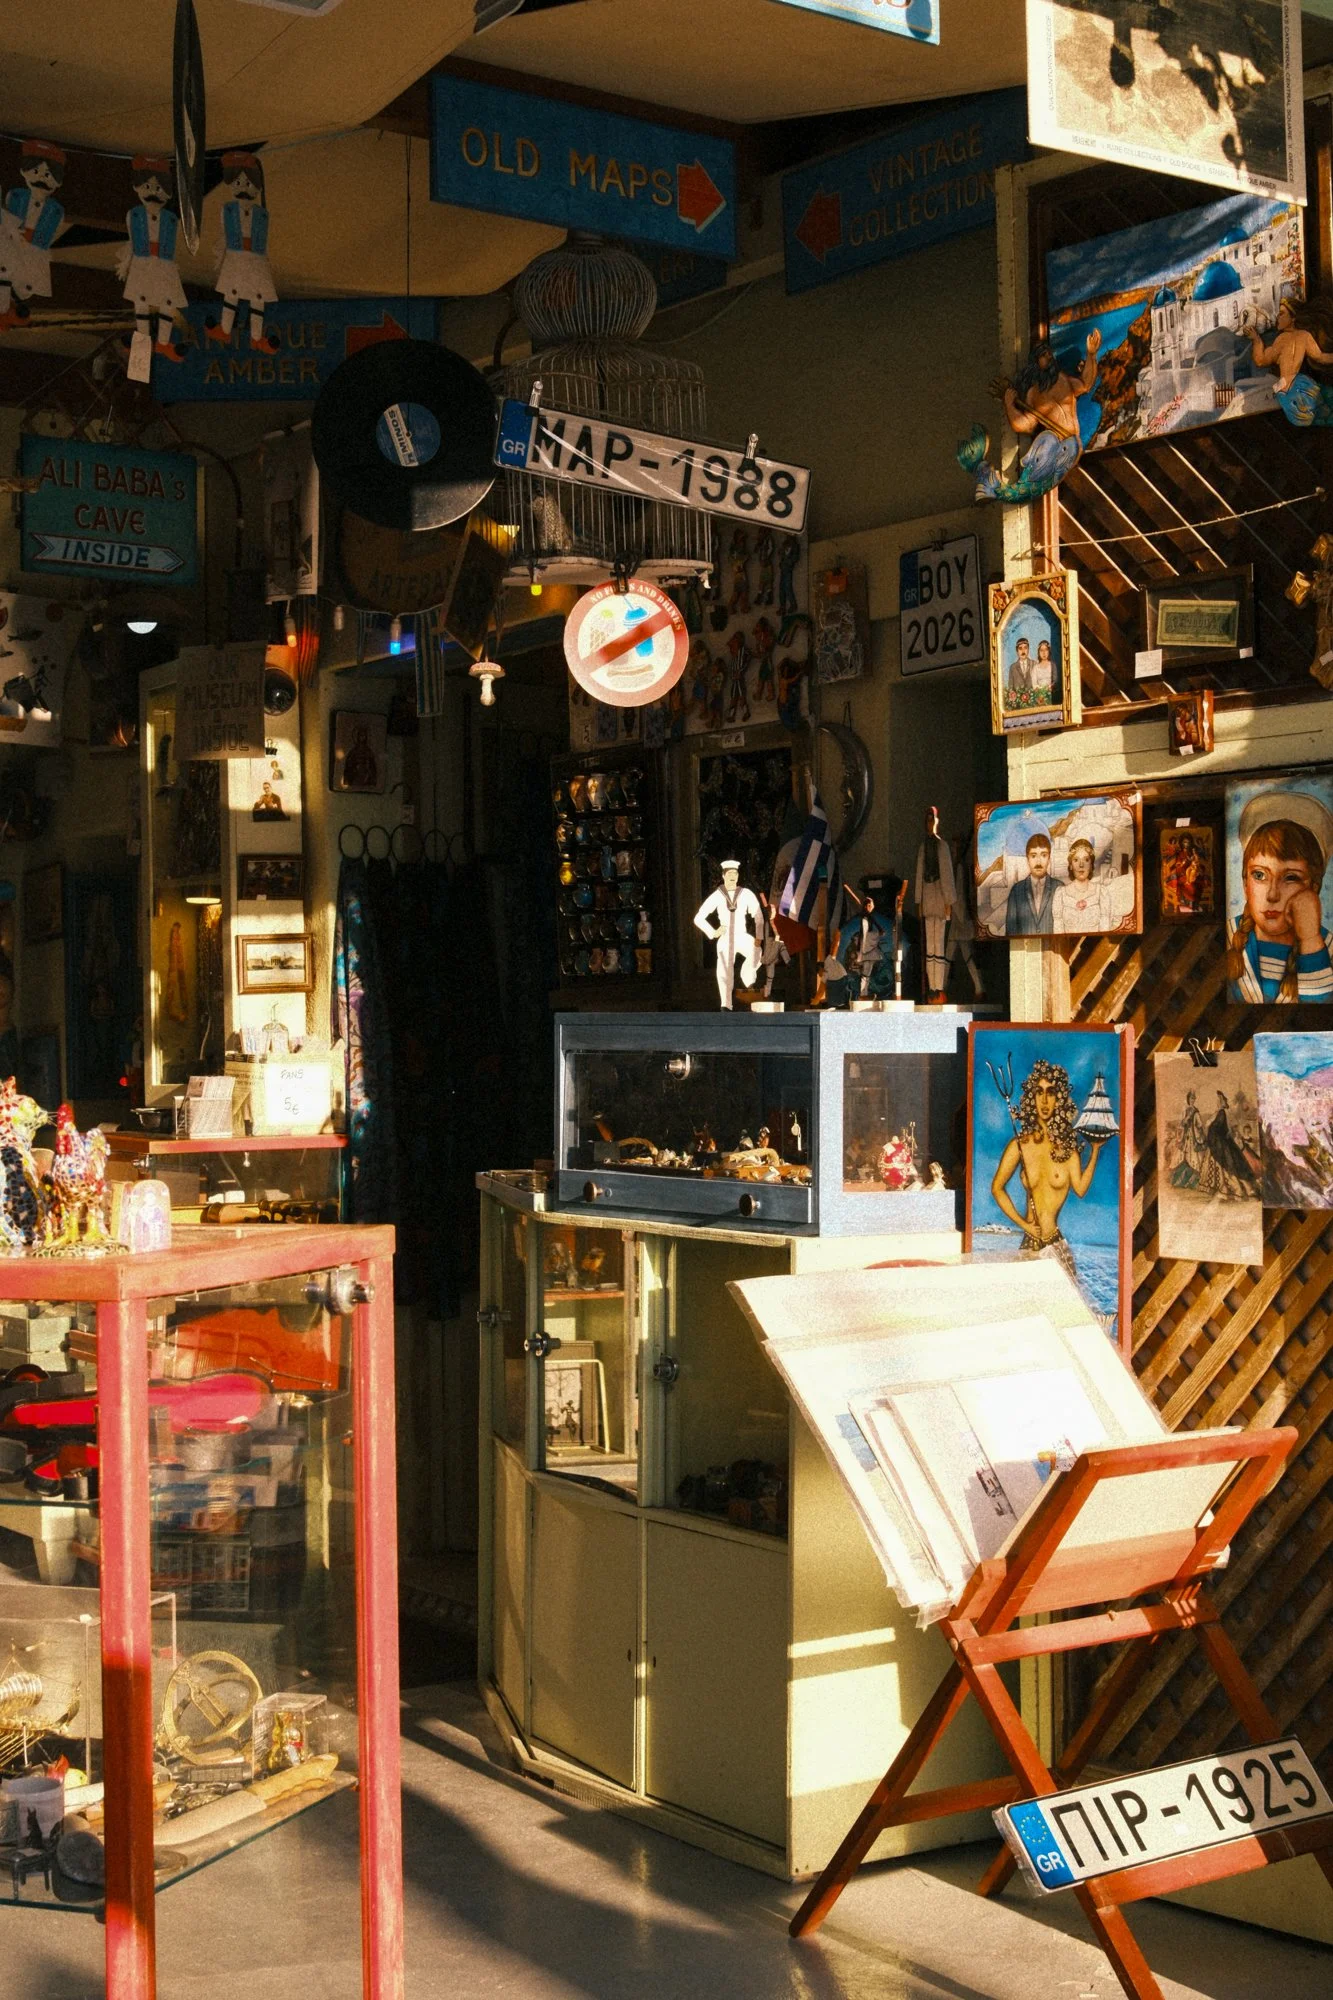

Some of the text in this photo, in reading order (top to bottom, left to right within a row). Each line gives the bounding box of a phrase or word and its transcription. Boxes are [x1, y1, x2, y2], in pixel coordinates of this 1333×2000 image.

[461, 126, 673, 207] OLD MAPS
[867, 122, 984, 194] VINTAGE
[204, 357, 321, 385] AMBER
[388, 410, 408, 454] MINOS
[502, 438, 525, 457] GR
[39, 455, 82, 489] ALI
[74, 503, 146, 535] CAVE
[62, 539, 151, 568] INSIDE
[920, 553, 968, 605] BOY
[590, 590, 604, 604] NO
[638, 584, 657, 598] AND
[657, 596, 683, 631] DRINKS
[903, 587, 918, 602] GR
[907, 607, 974, 660] 2026
[183, 682, 258, 711] MUSEUM
[193, 723, 250, 752] INSIDE
[281, 1068, 304, 1080] FANS
[1036, 1850, 1066, 1874] GR
